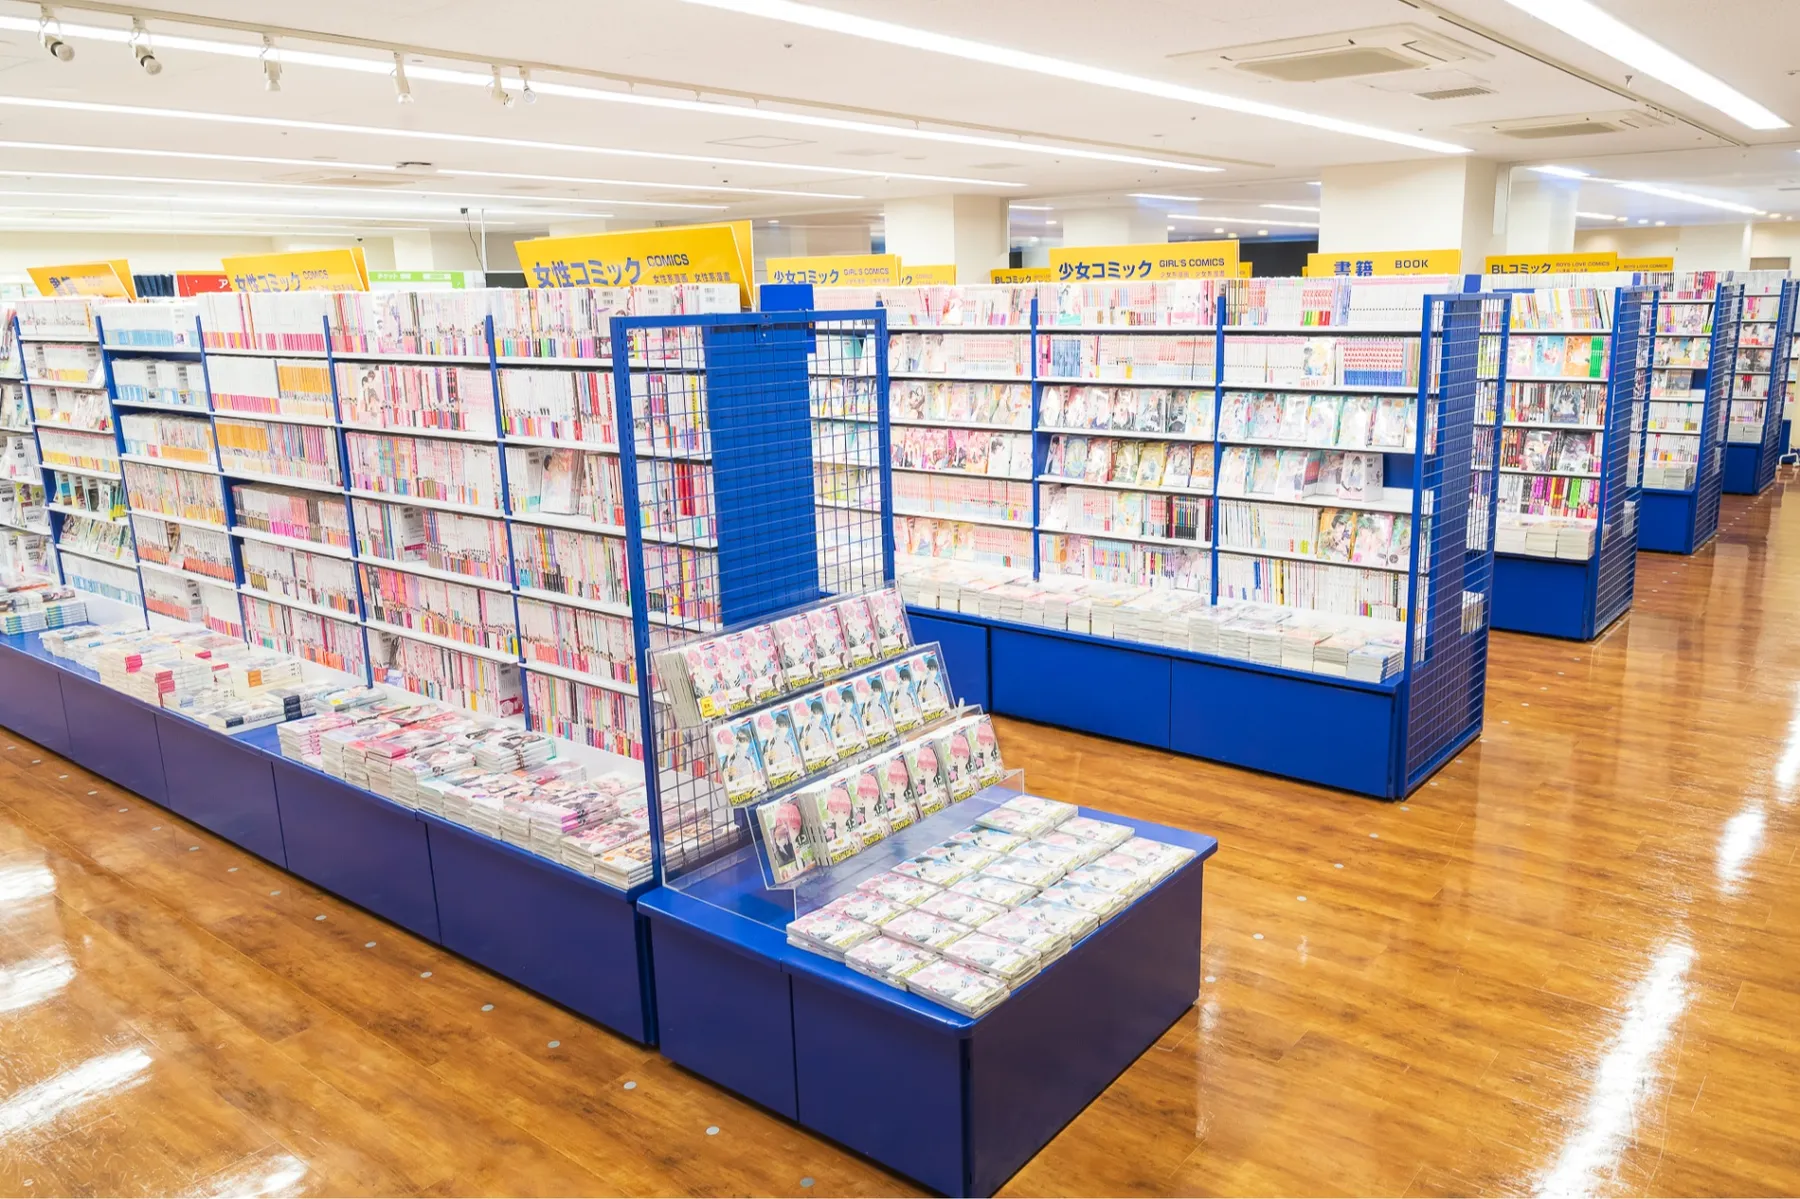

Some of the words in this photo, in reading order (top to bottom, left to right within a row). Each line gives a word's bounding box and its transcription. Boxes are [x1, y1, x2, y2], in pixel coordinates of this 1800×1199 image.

[646, 253, 690, 267] COMICS
[1159, 259, 1187, 268] GIRL'S
[1189, 258, 1225, 267] COMICS
[1395, 259, 1429, 269] BOOK
[303, 269, 329, 280] COMICS
[532, 257, 642, 288] 女性コミック
[864, 267, 889, 275] COMICS
[1058, 259, 1153, 281] 少女コミック
[1333, 260, 1374, 276] 書籍
[1491, 262, 1552, 274] BLコミック
[235, 271, 301, 292] 女性コミック
[773, 268, 840, 284] 少女コミック
